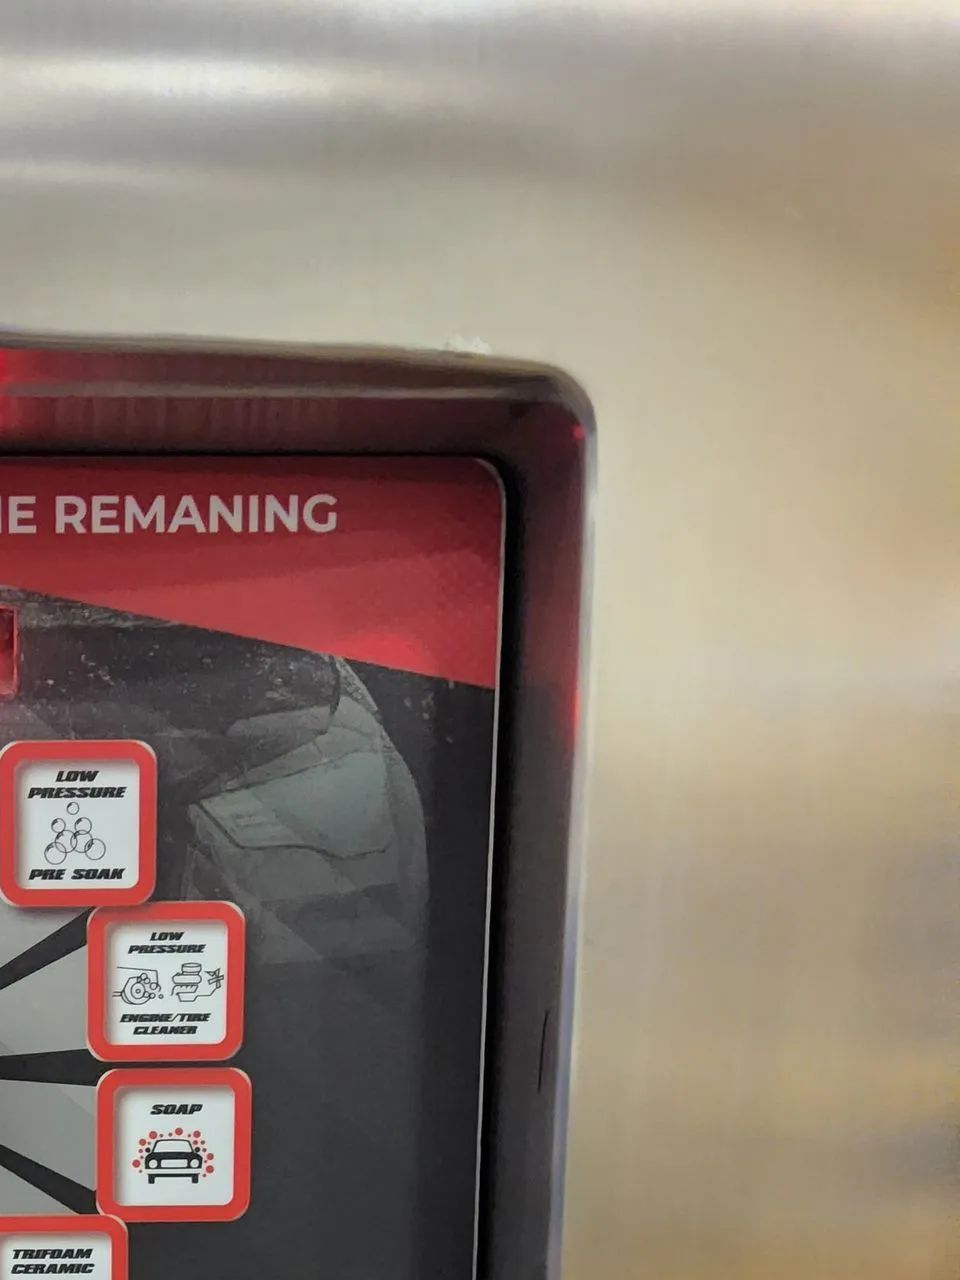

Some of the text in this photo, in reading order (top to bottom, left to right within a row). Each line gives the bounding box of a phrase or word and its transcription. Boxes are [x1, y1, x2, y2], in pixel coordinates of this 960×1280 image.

[54, 493, 338, 535] REMANING
[55, 770, 99, 782] LOW
[27, 786, 127, 799] PRESSURE
[28, 868, 126, 880] PRE SOAK
[150, 931, 185, 942] LOW
[128, 944, 206, 955] PRESSURE
[120, 1013, 211, 1023] ENGINE/TIRE
[133, 1026, 198, 1035] CLEANER
[150, 1104, 203, 1115] SOAP
[13, 1249, 93, 1260] TRIFOAM
[11, 1263, 95, 1275] CERAMIC
